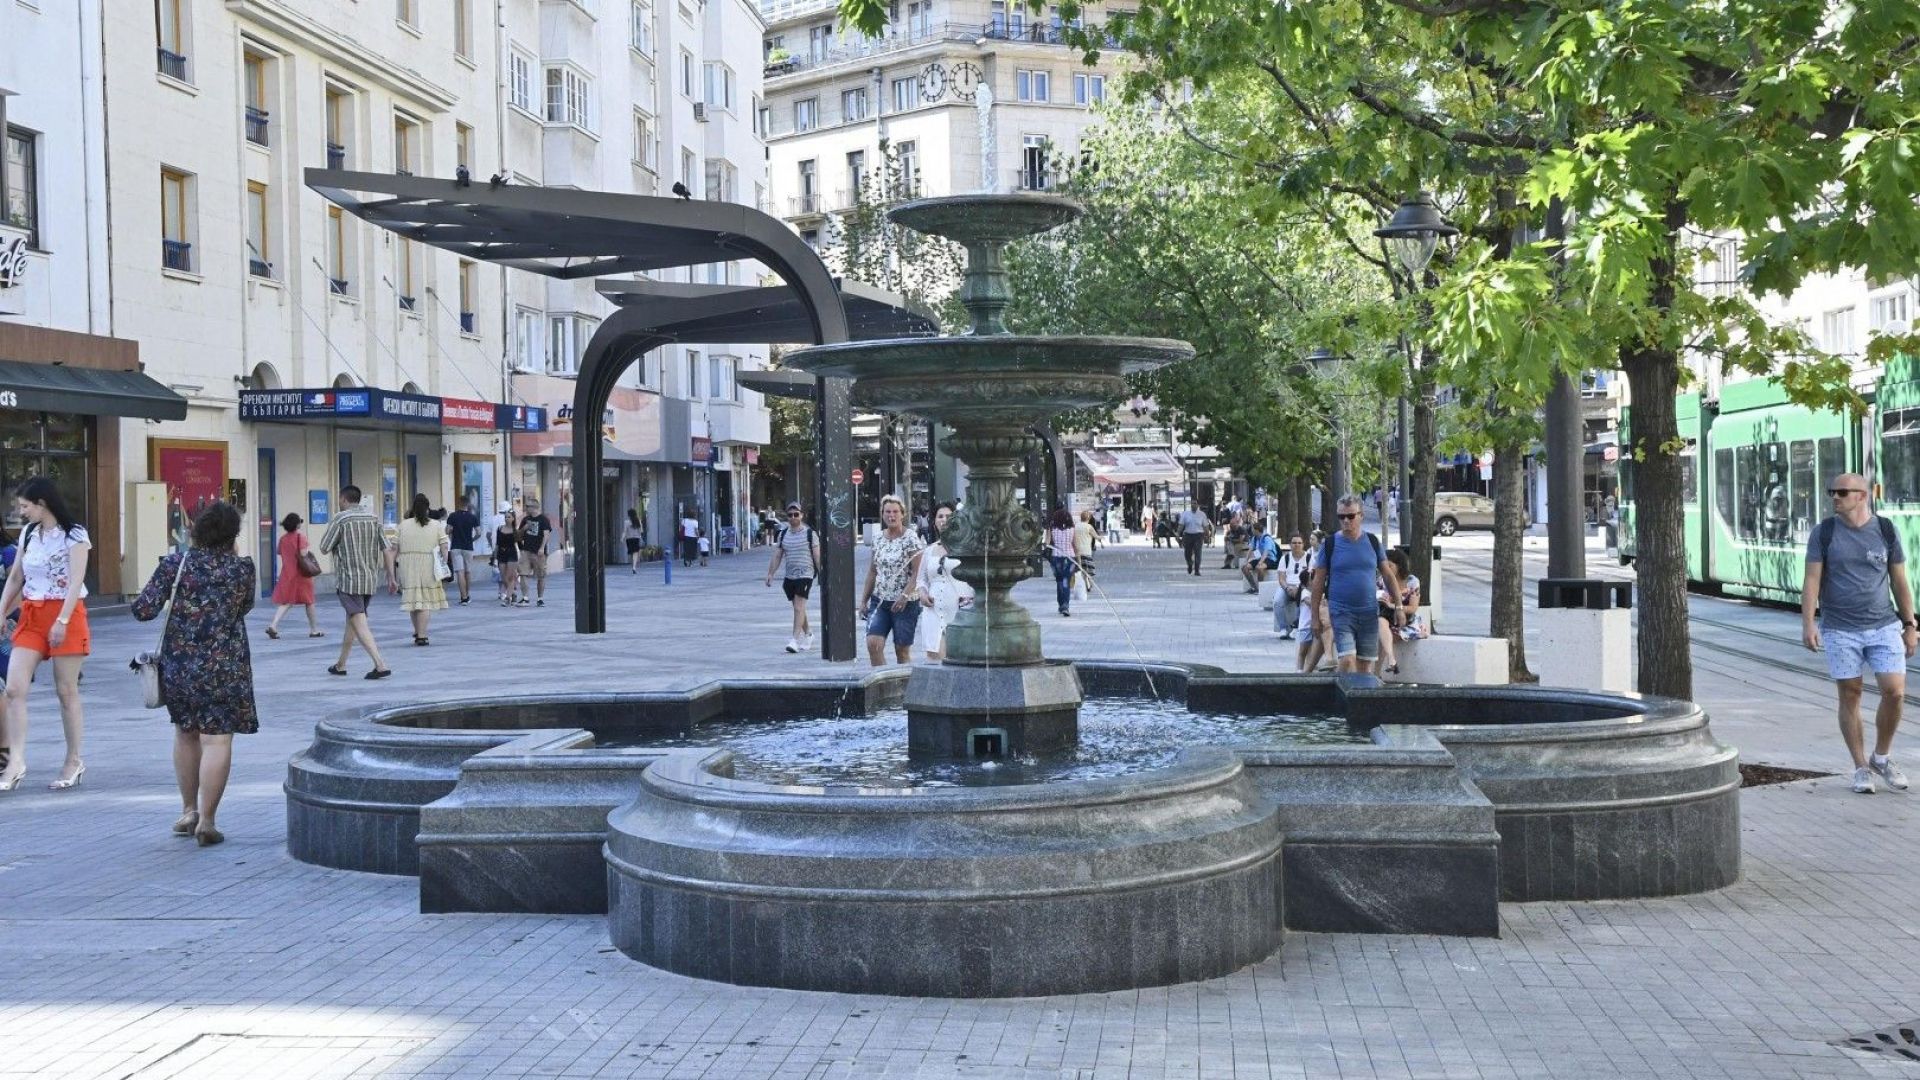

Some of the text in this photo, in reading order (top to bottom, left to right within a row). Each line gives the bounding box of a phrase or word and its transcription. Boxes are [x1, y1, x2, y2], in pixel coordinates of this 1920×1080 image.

[242, 393, 302, 405] ФРЕНСКИ ИНСТИТУТ
[253, 405, 302, 416] БЪЛГАРИЯ
